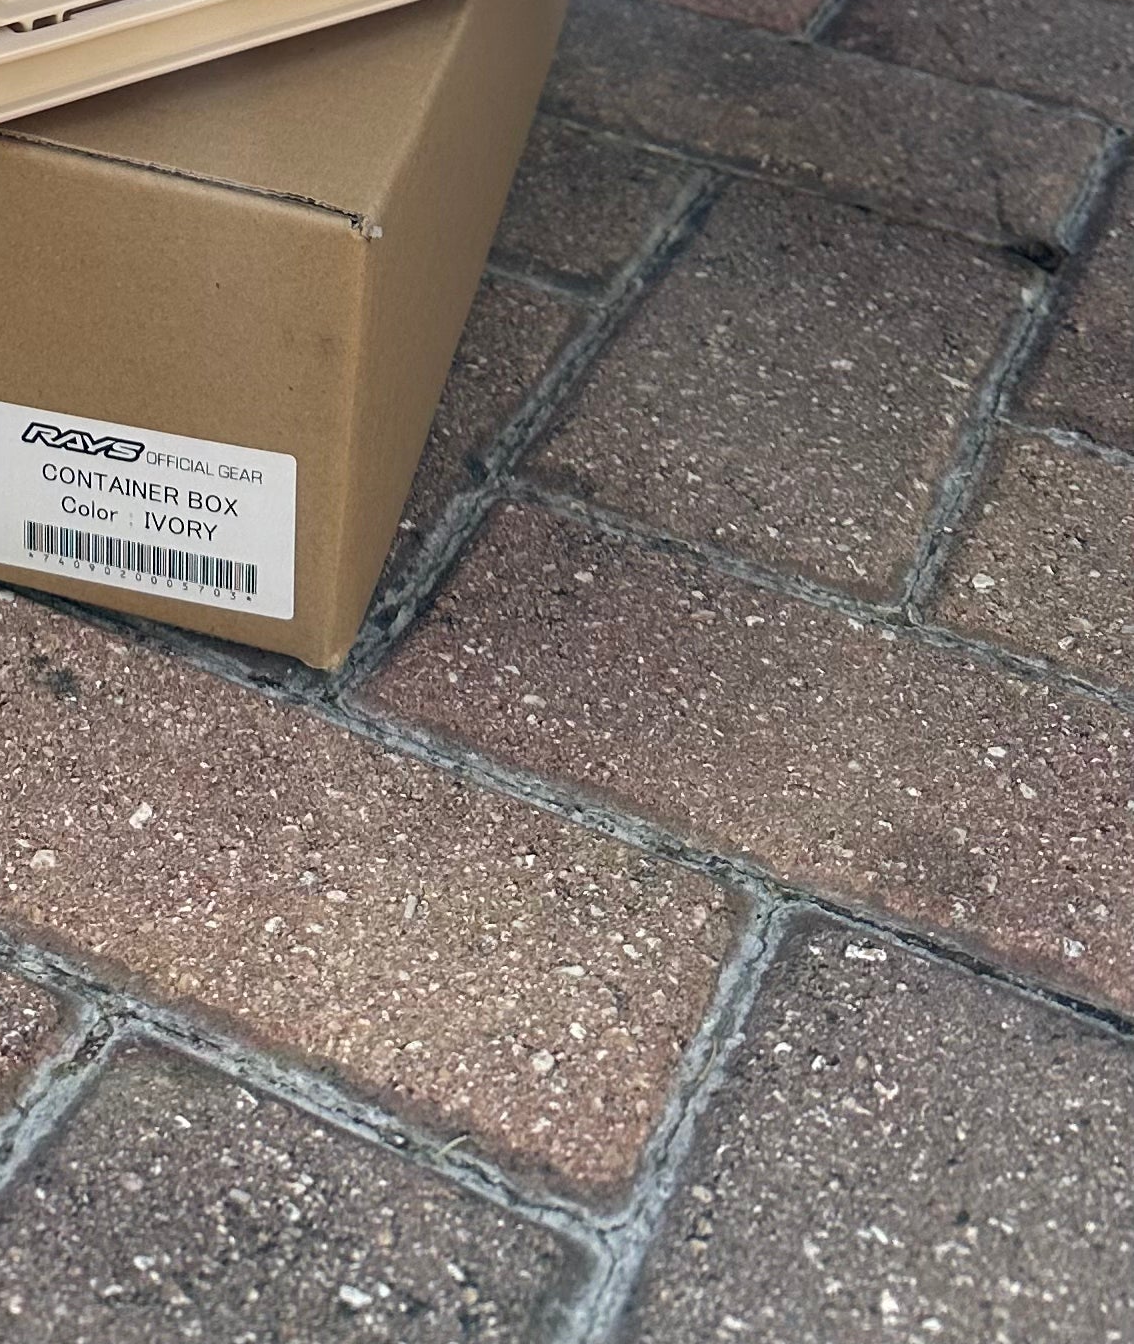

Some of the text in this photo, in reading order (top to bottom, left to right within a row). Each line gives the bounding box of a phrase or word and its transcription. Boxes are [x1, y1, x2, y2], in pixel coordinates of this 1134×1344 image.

[21, 421, 263, 485] RAYS OFFICIAL GEAR
[42, 463, 238, 518] CONTAINER BOX
[61, 495, 119, 522] Color
[144, 511, 218, 542] IVORY
